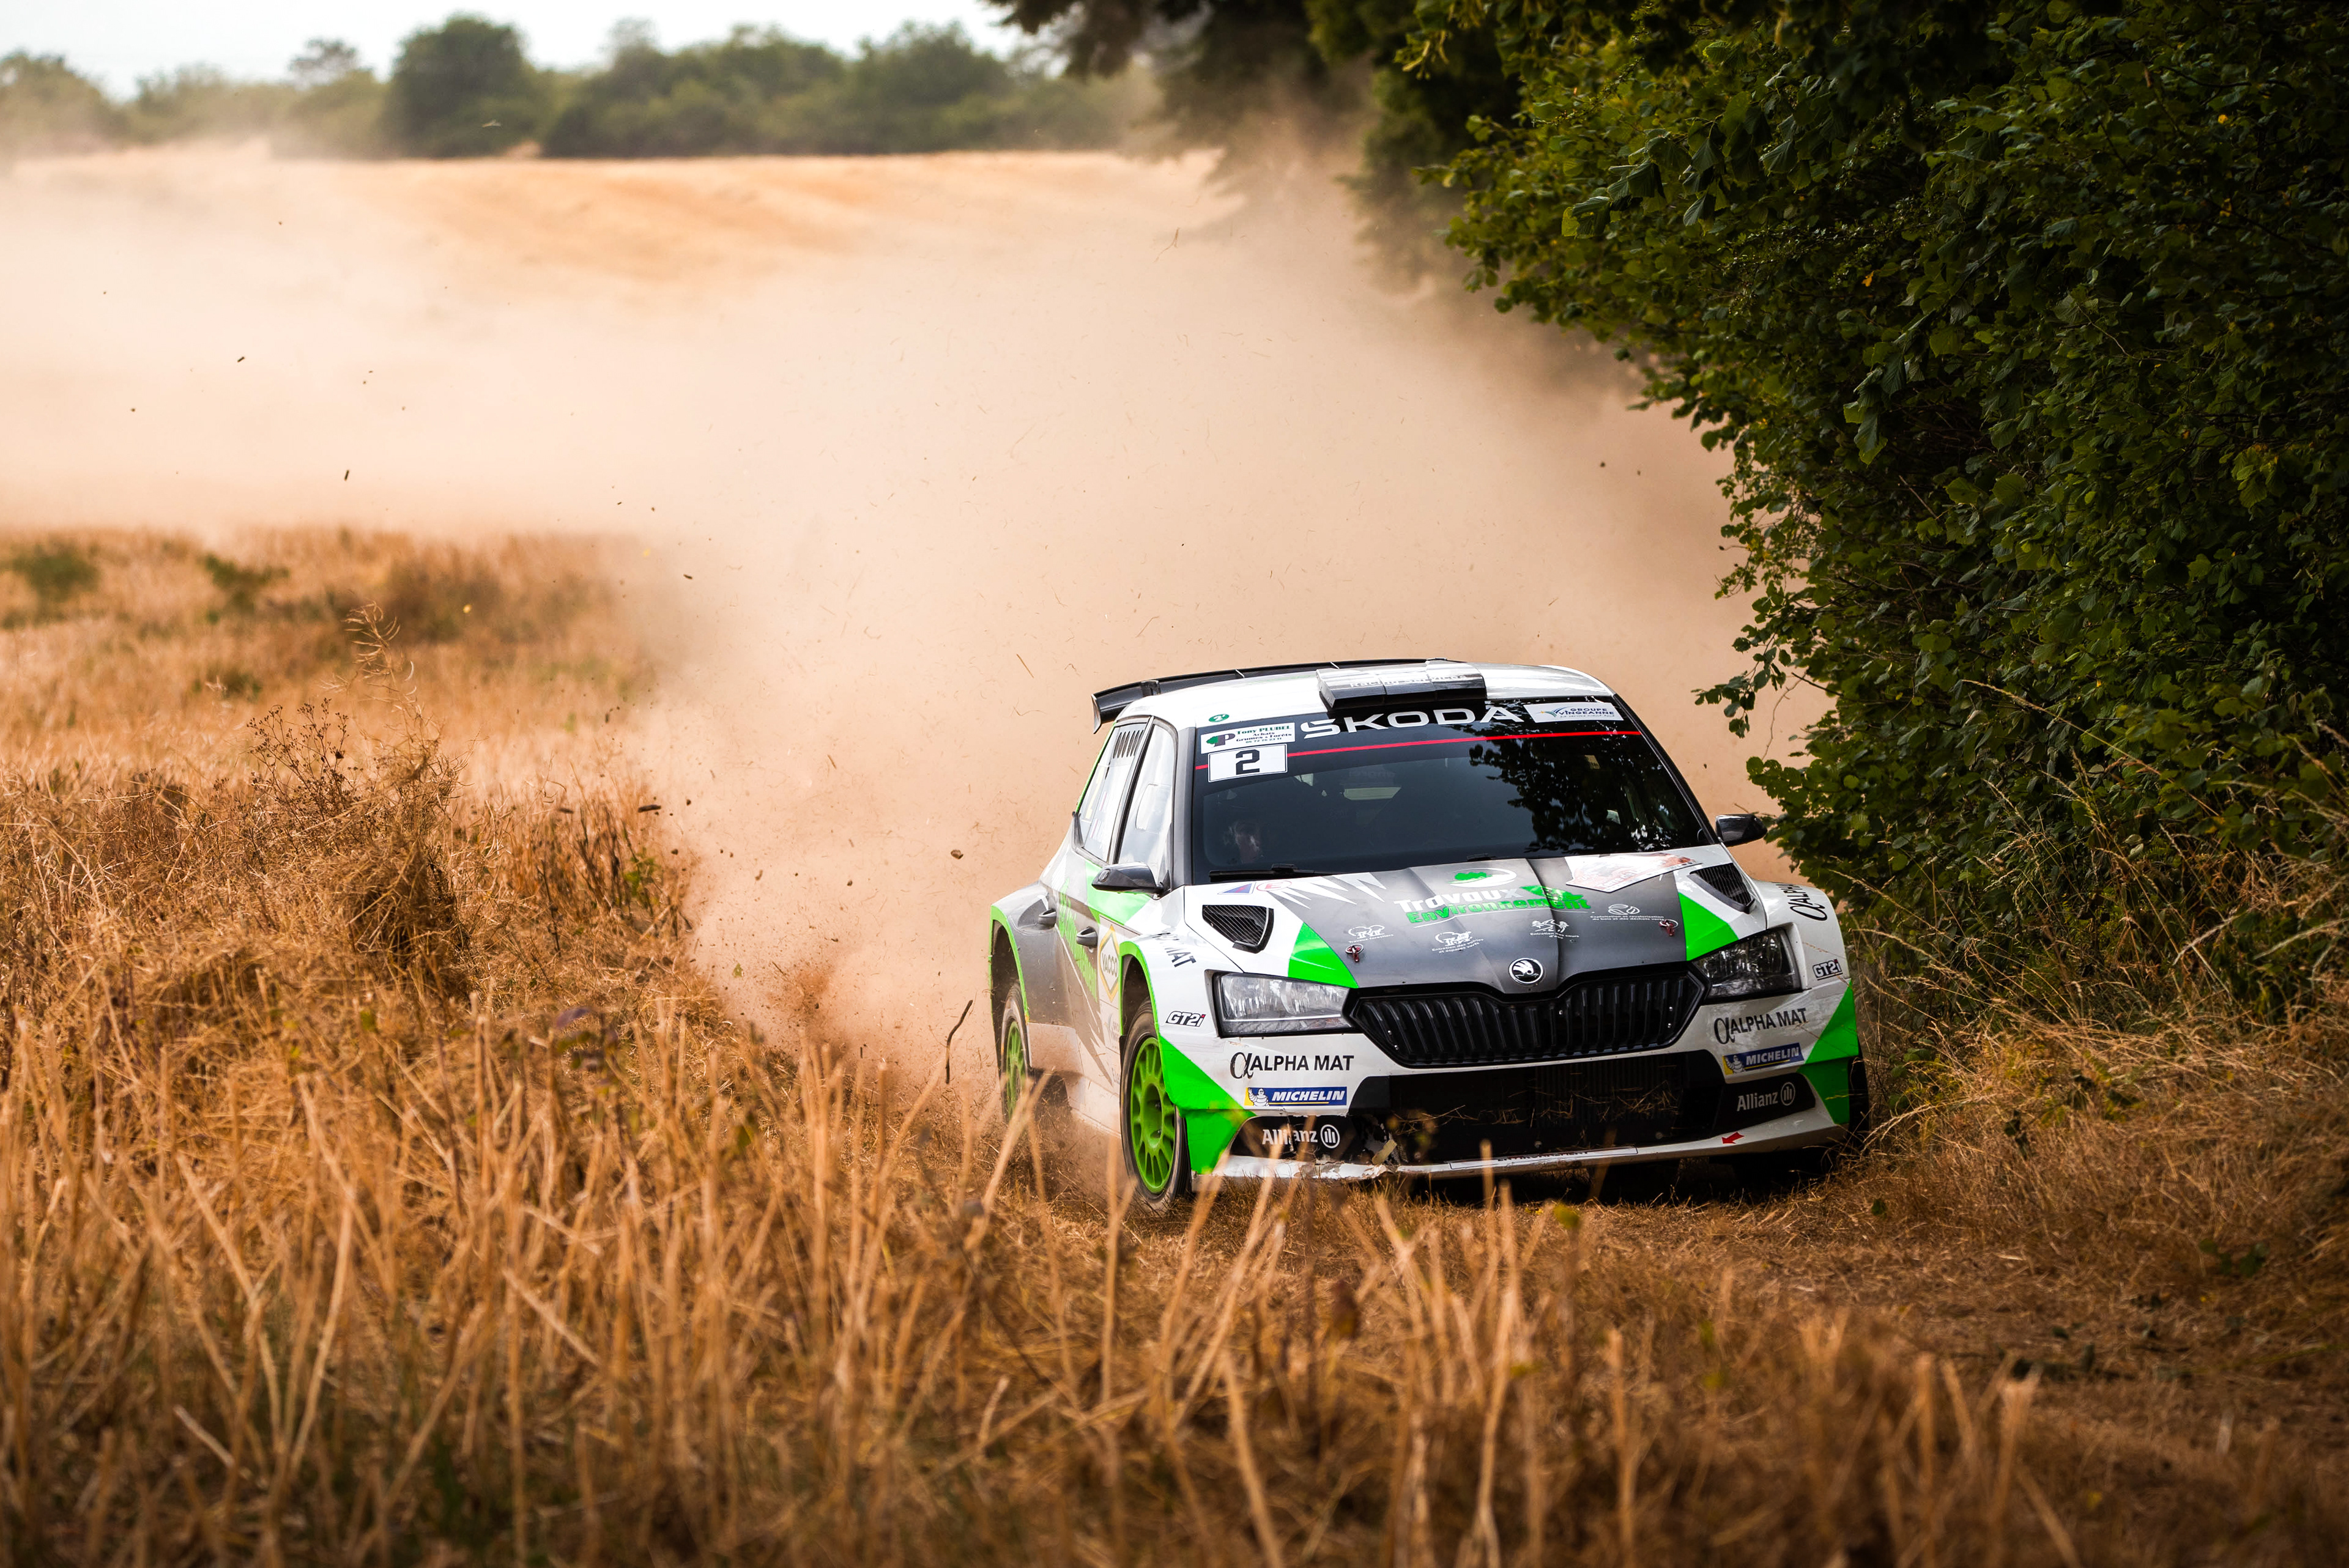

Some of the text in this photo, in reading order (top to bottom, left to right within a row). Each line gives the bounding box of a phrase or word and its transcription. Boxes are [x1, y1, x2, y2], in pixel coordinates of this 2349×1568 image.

[1236, 749, 1260, 775] 2
[1393, 888, 1524, 912] Travaux
[1406, 898, 1591, 923] Environnement
[1102, 953, 1118, 978] YACCO
[1813, 959, 1842, 978] GT2i
[1165, 1010, 1206, 1027] GT2i
[1731, 1013, 1776, 1035] ALPHA
[1776, 1008, 1806, 1027] MAT
[1250, 1056, 1309, 1071] ALPHA
[1315, 1056, 1354, 1071] MAT
[1746, 1046, 1800, 1066] MICHELIN
[1272, 1091, 1345, 1101] MICHELIN
[1737, 1092, 1779, 1112] Allianz
